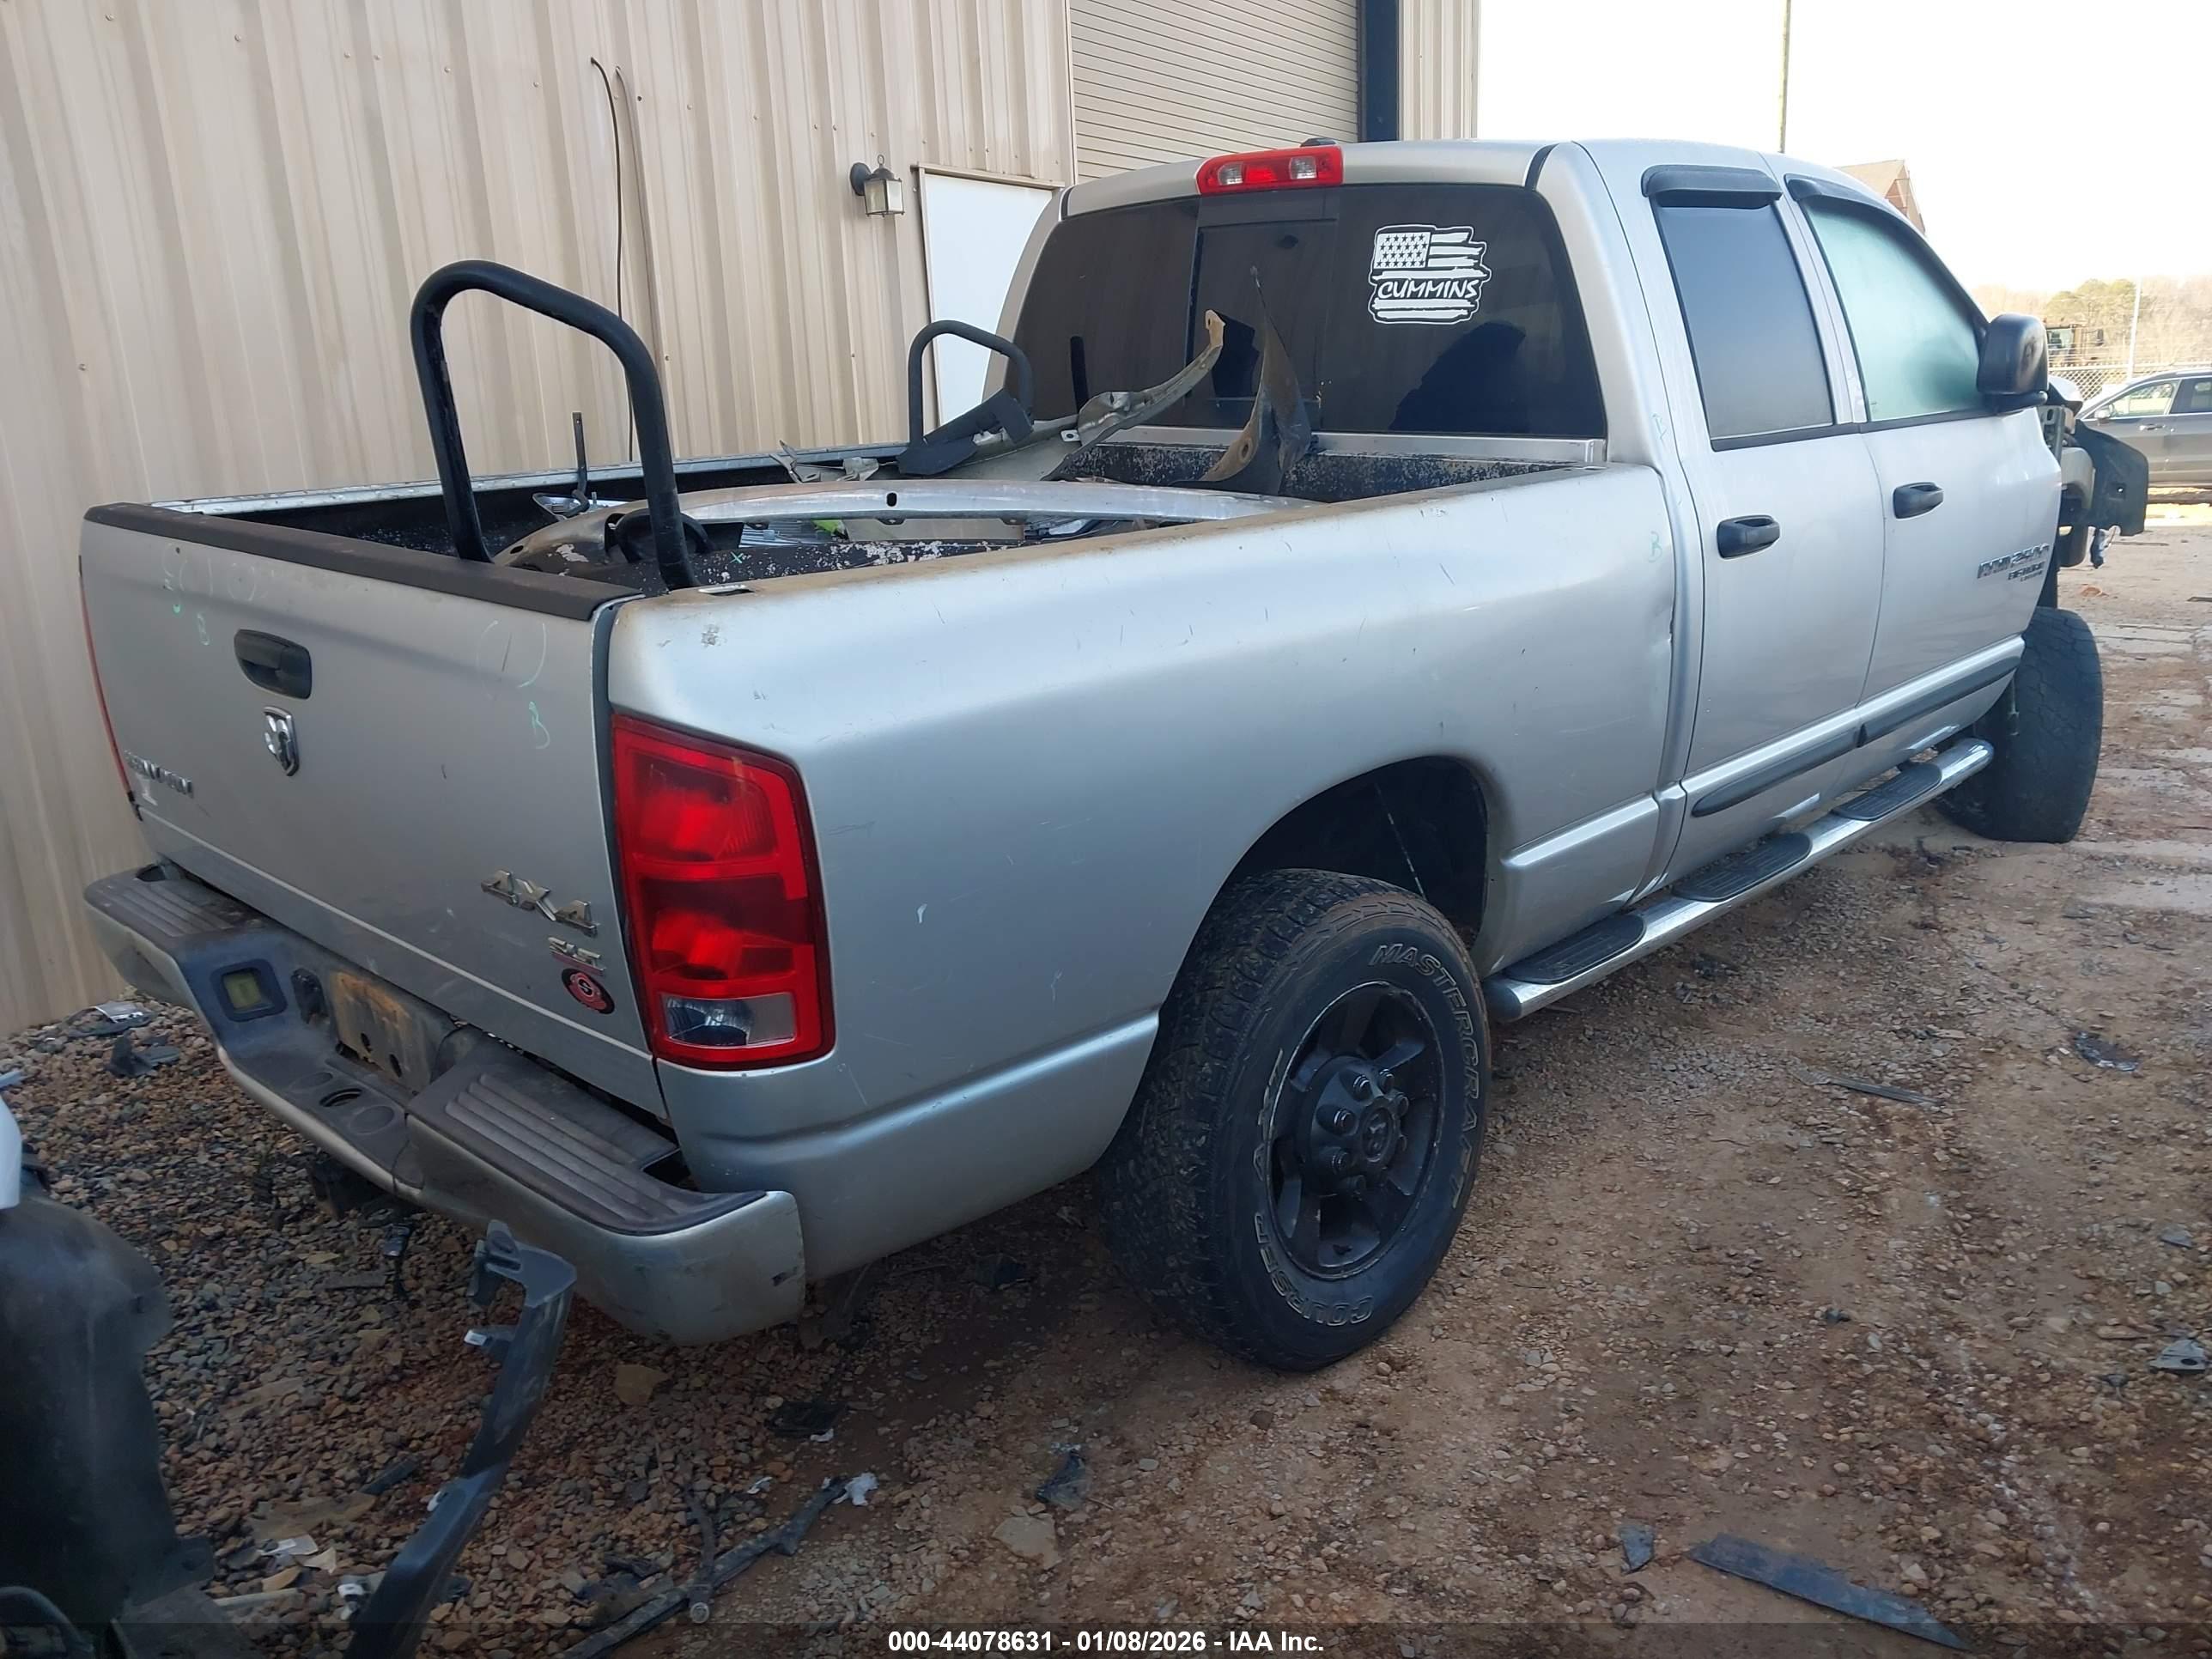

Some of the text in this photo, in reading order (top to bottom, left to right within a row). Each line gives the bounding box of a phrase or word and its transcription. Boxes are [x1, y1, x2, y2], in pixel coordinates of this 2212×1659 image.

[1376, 279, 1480, 300] CUMMINS
[1367, 943, 1480, 1211] MASTERCRAFT
[1253, 1212, 1375, 1328] COURSER
